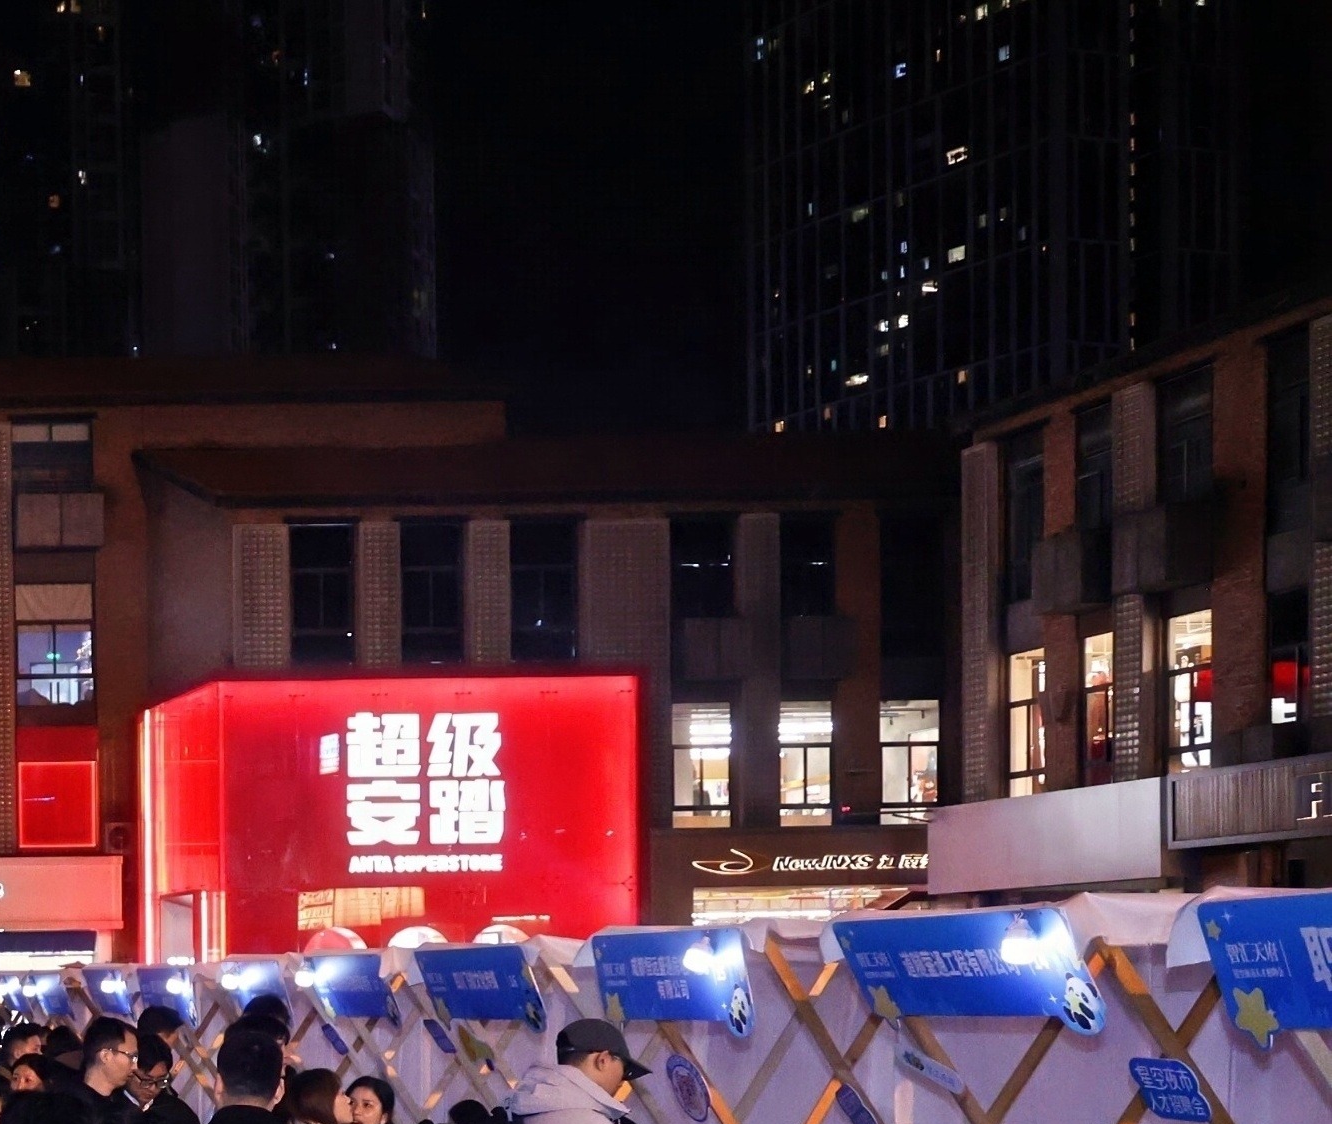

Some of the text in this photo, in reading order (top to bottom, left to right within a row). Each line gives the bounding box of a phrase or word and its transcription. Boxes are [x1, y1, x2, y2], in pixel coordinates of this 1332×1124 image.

[346, 711, 502, 778] 超级
[346, 779, 507, 846] 安踏
[348, 853, 503, 874] ANTA SUPERSTORE
[1135, 1064, 1194, 1093] 星空夜市
[1149, 1091, 1206, 1116] 人才招聘会
